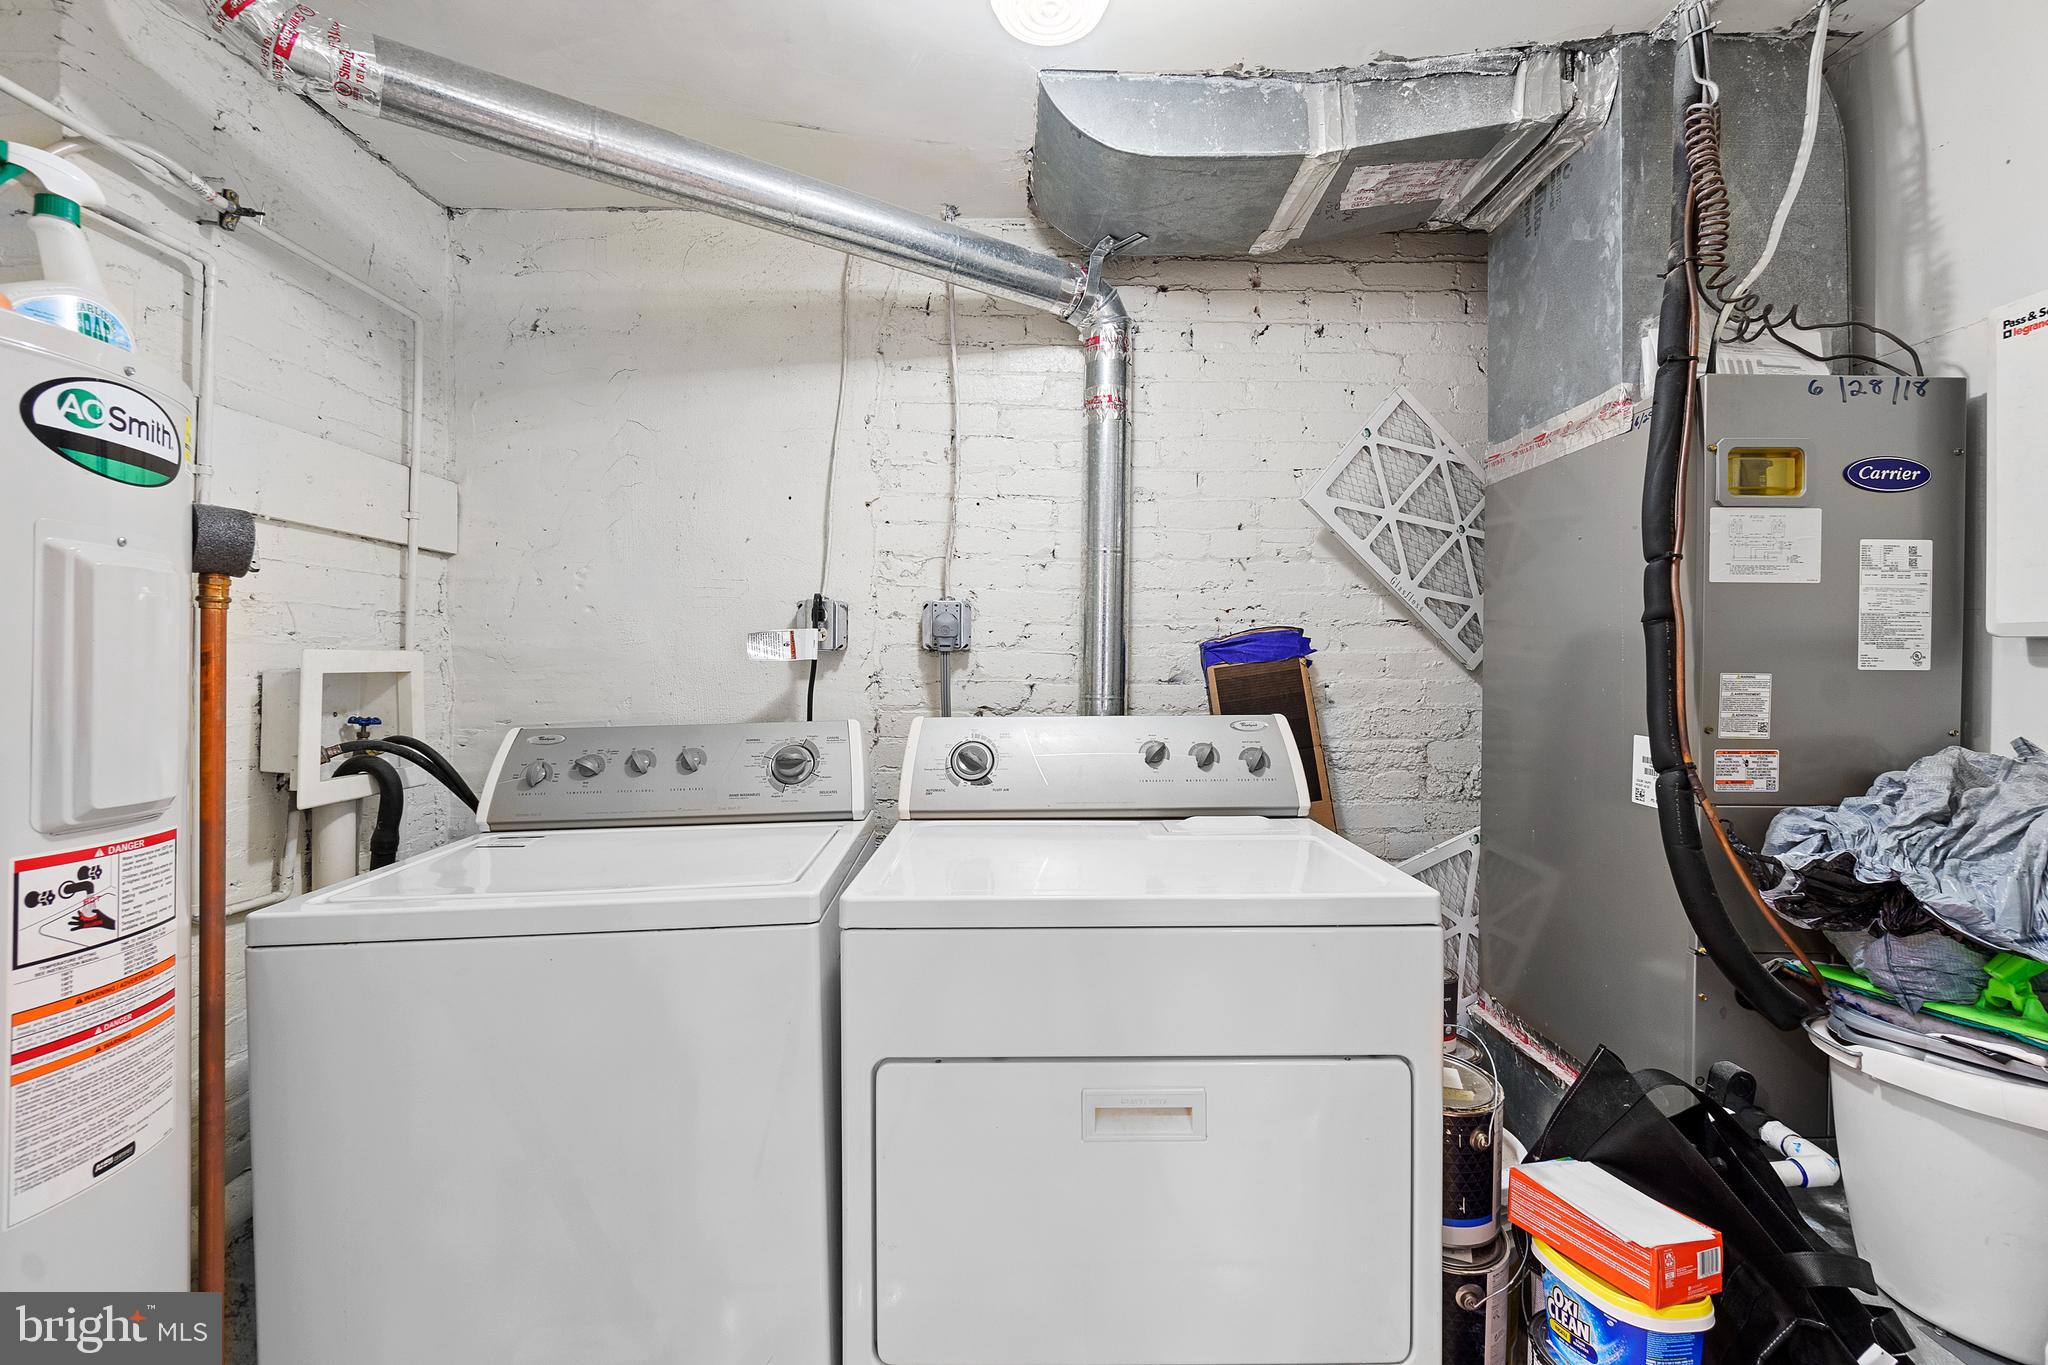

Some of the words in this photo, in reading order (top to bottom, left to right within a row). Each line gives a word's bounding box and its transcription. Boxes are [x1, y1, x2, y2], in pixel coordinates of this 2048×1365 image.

[2002, 316, 2027, 330] Pass
[2027, 311, 2038, 321] &
[108, 405, 174, 450] Smith
[1858, 464, 1921, 482] Carrier
[1389, 576, 1425, 613] Glasfloss
[107, 839, 145, 855] DANGER
[103, 1013, 133, 1031] DANGER
[1553, 1286, 1579, 1320] OXI
[1547, 1296, 1590, 1343] CLEAN
